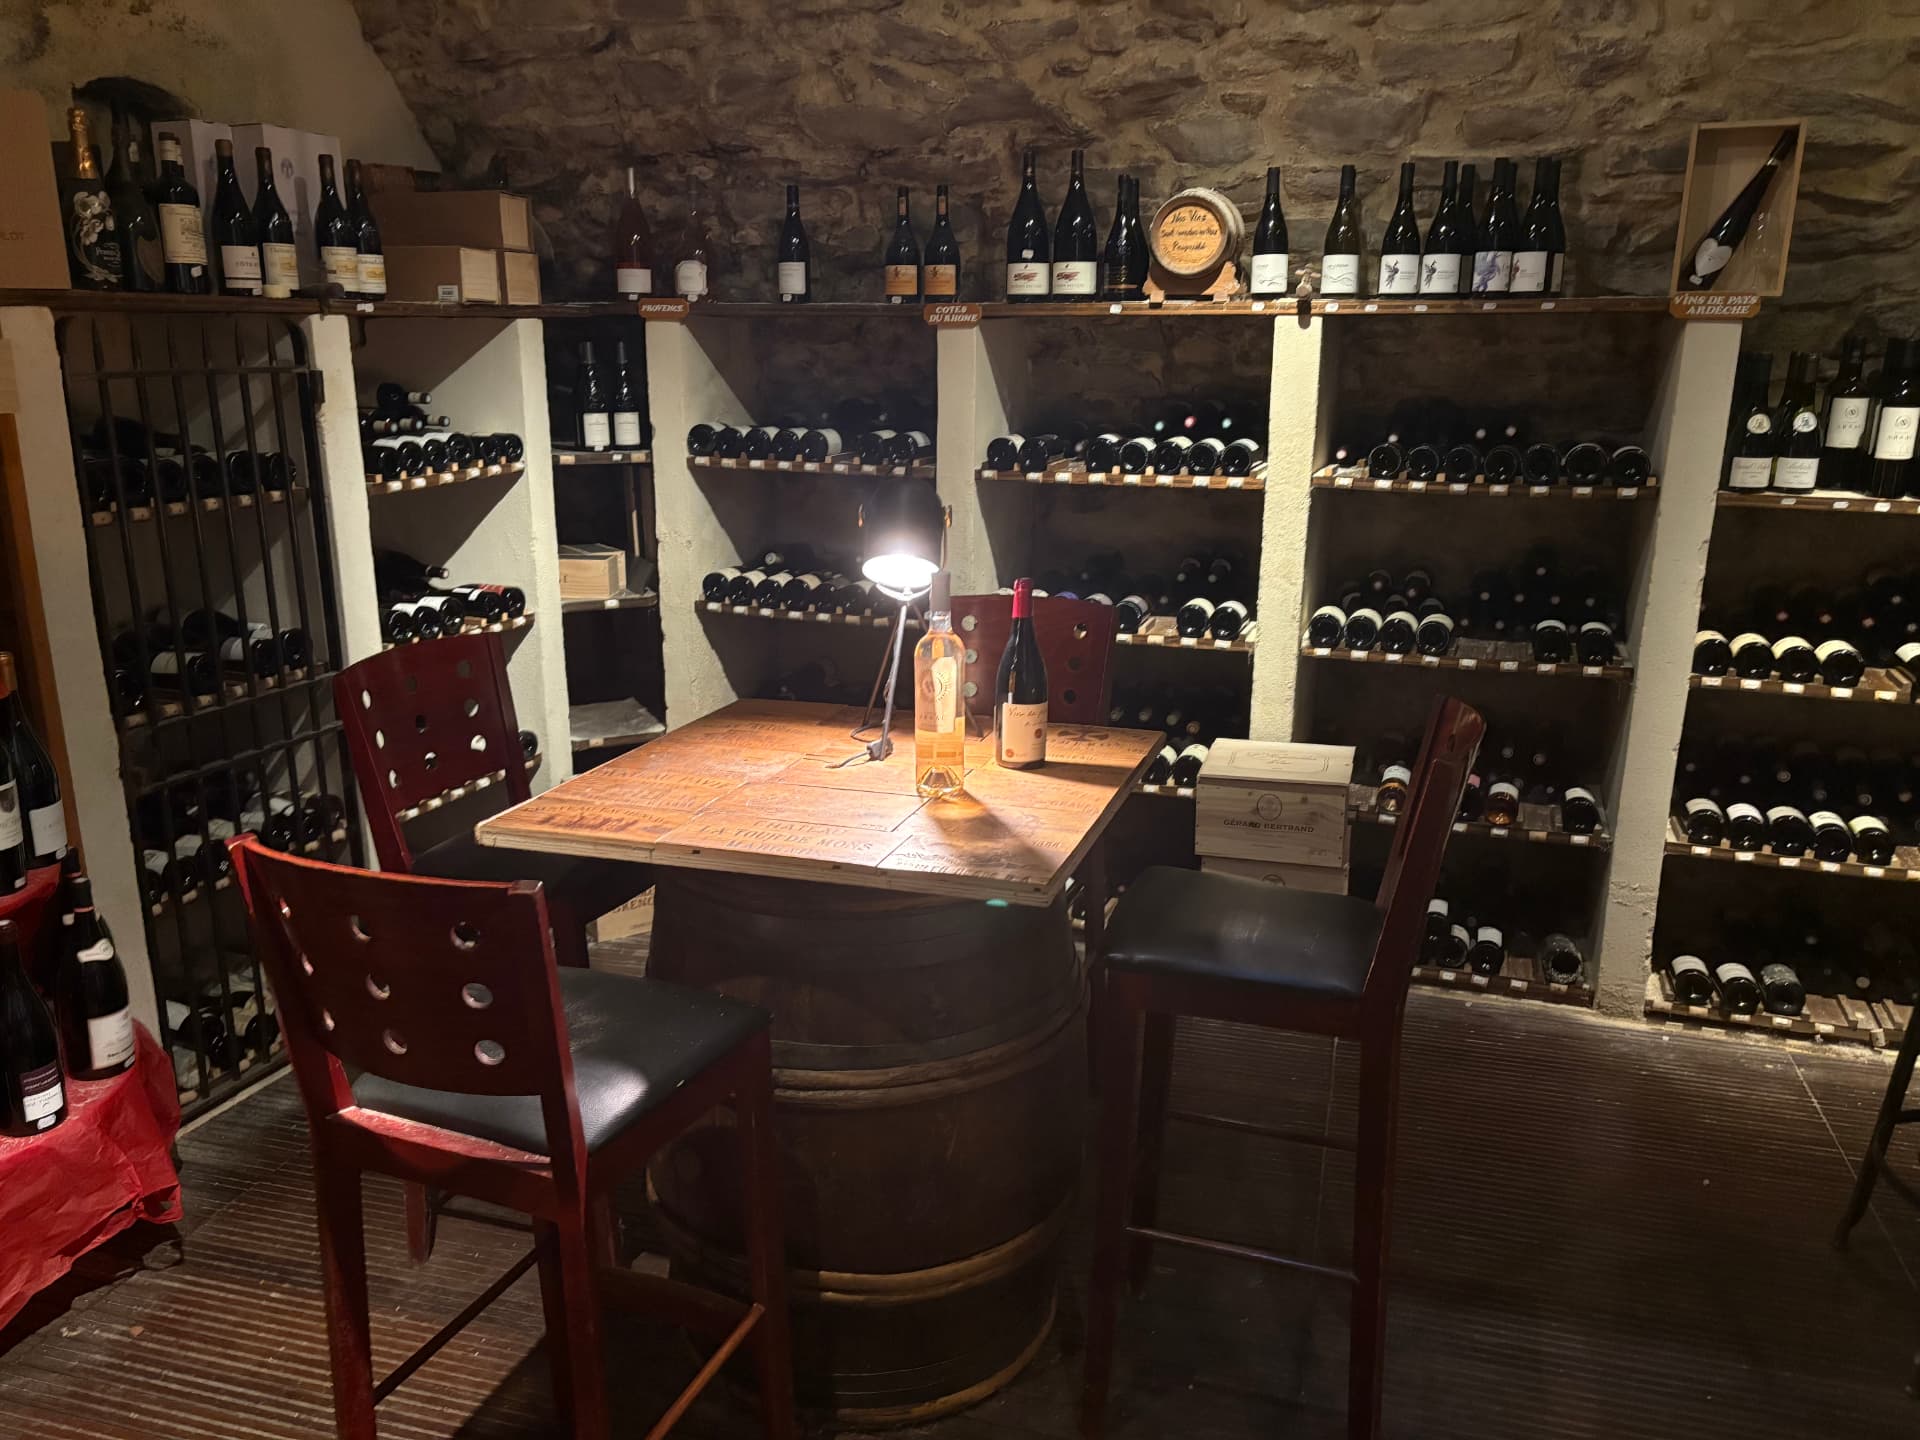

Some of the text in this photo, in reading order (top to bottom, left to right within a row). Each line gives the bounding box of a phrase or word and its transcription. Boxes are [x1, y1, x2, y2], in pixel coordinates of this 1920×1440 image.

[1674, 293, 1760, 305] VINS DE PAYS
[641, 304, 685, 312] PROVENCE
[928, 314, 944, 322] DU
[1223, 817, 1315, 833] GÉRARD BERTRAND
[784, 833, 810, 844] DE
[816, 837, 874, 851] MONS
